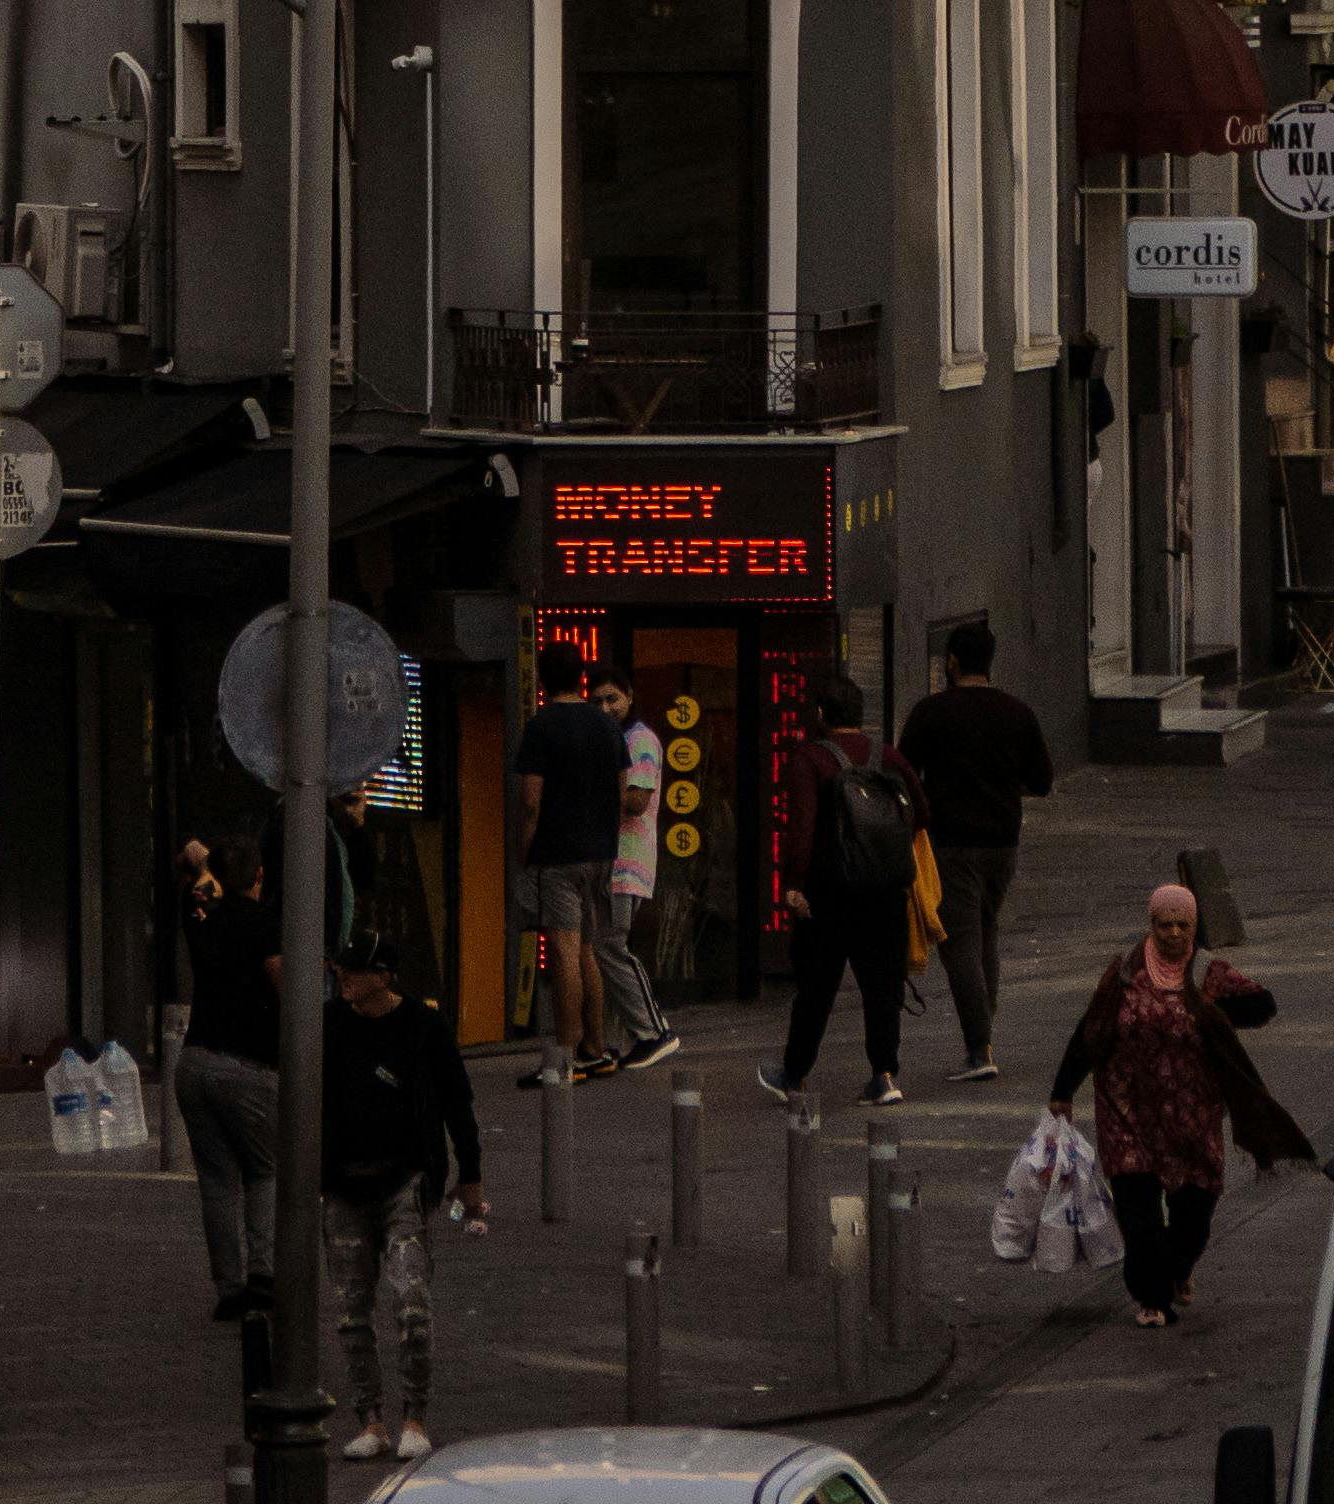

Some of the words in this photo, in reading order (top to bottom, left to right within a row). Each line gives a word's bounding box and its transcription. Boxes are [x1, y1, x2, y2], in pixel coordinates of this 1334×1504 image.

[1269, 123, 1316, 150] MAY
[1135, 233, 1241, 266] cordis
[1193, 271, 1240, 285] hotel
[556, 484, 722, 520] MONEY
[556, 539, 810, 575] TRANSFER
